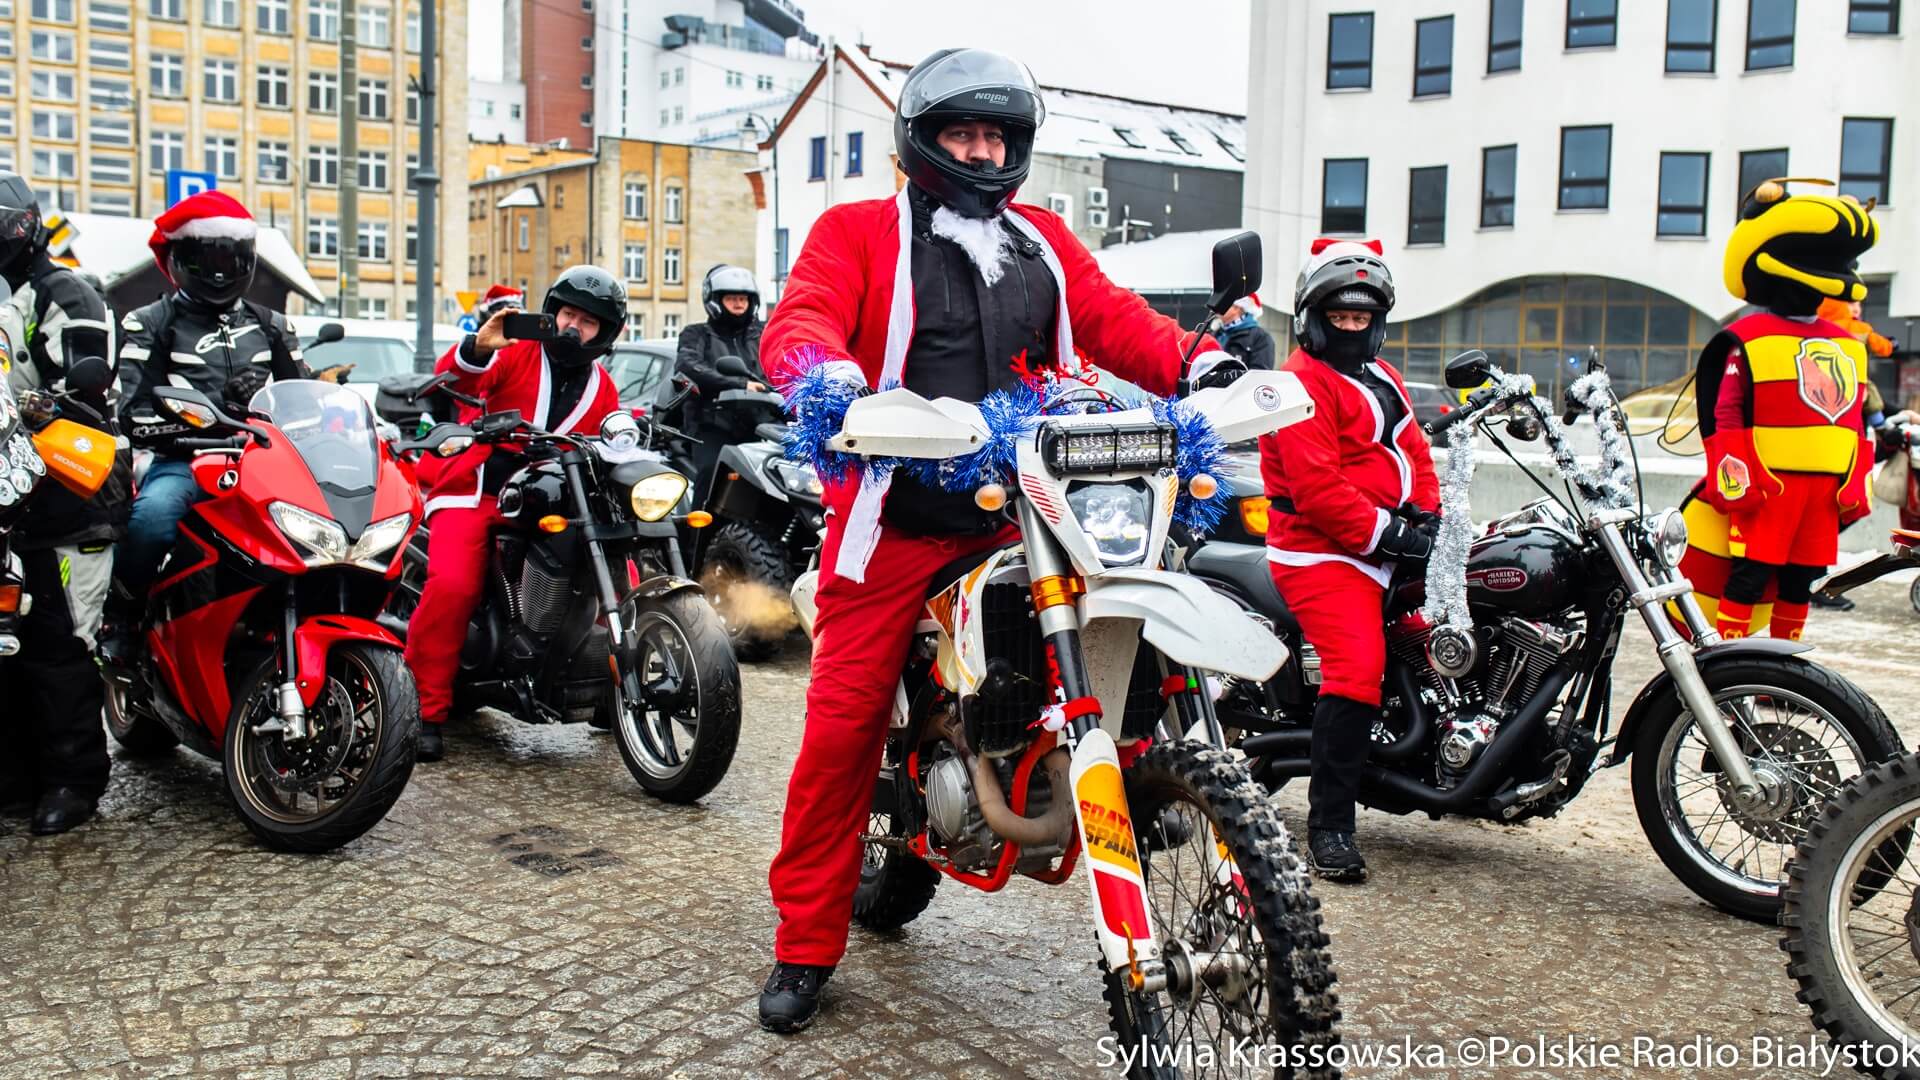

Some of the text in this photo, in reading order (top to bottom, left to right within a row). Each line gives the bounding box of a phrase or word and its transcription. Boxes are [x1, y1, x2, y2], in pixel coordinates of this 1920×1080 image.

[974, 92, 1009, 102] NOLAN
[180, 175, 208, 201] P
[1084, 824, 1138, 863] SPAIN
